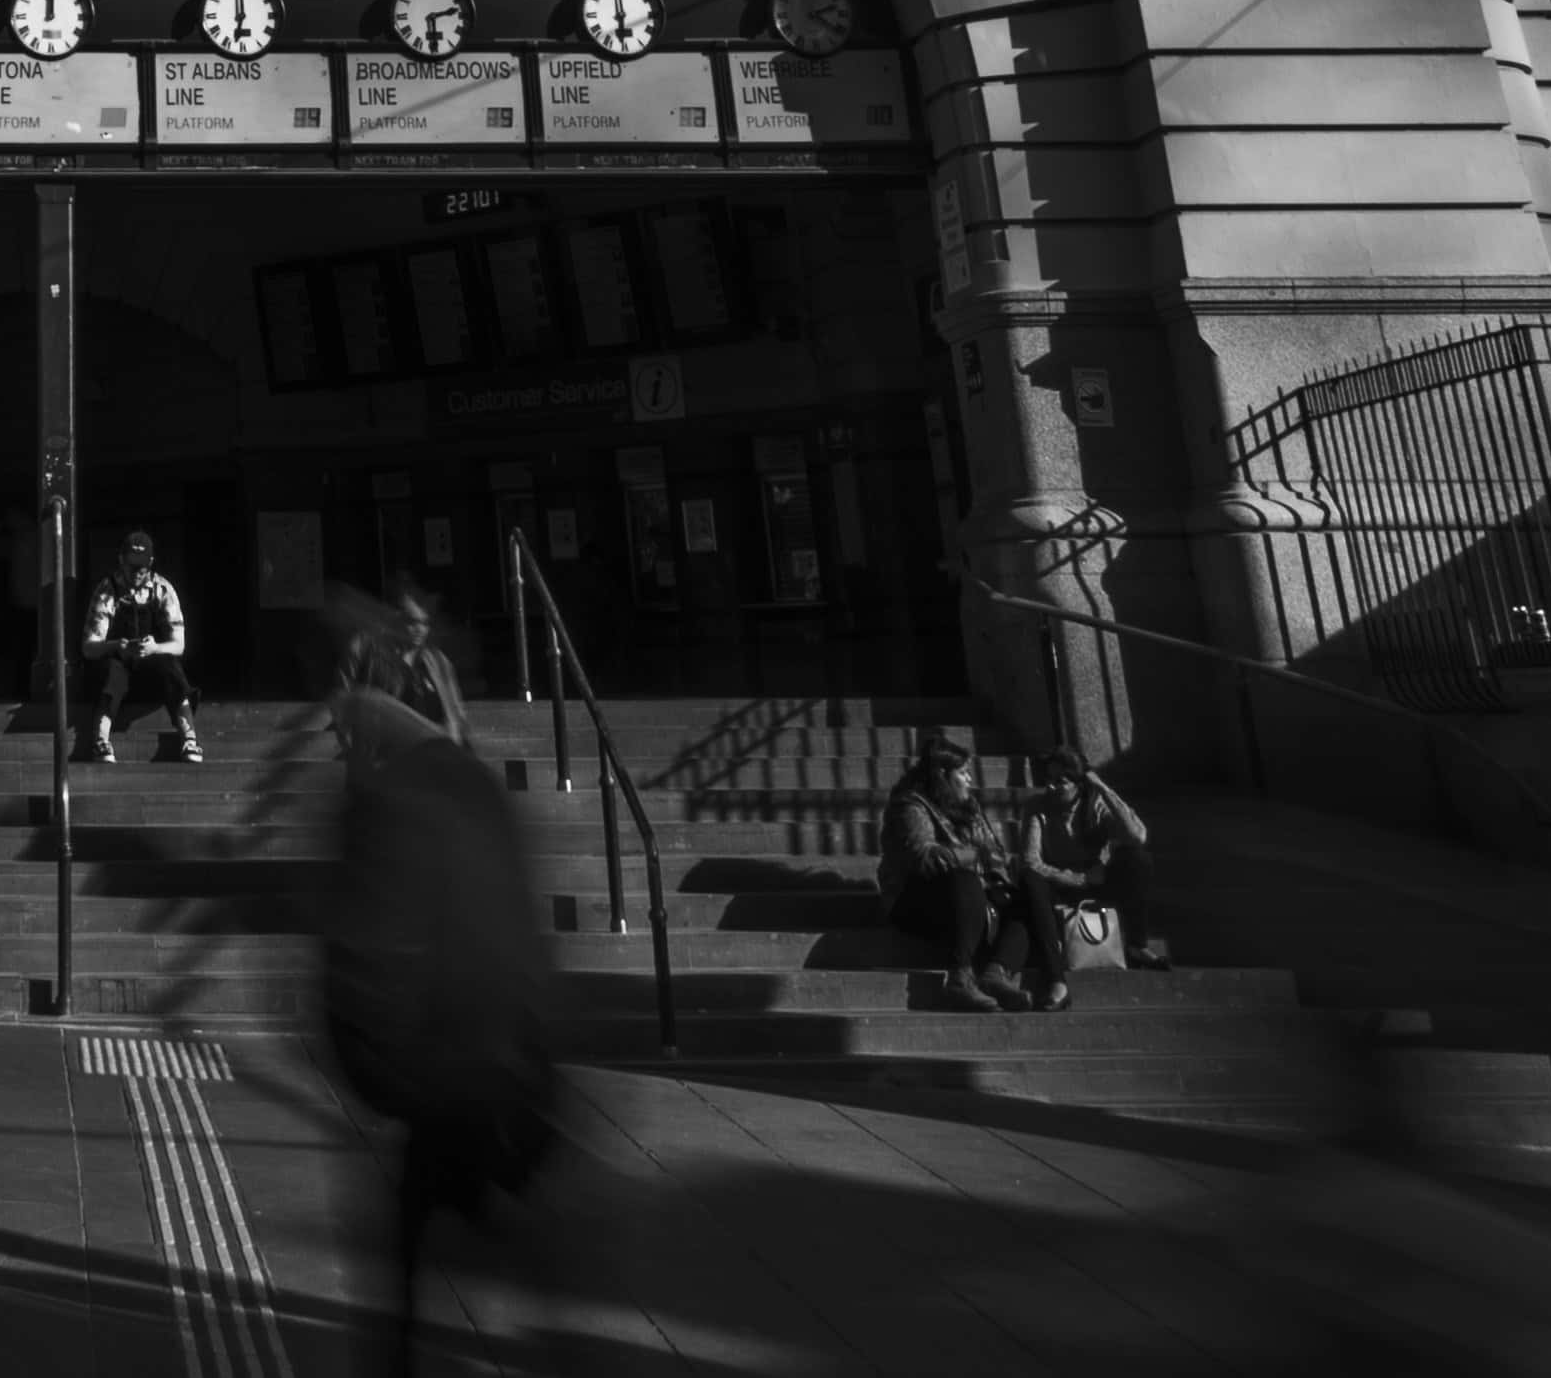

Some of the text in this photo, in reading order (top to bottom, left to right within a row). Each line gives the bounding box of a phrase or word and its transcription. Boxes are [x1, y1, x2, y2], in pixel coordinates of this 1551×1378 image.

[165, 62, 262, 81] ST ALBANS
[355, 62, 511, 81] BROADMEADOWS
[548, 61, 622, 79] UPFIELD
[739, 60, 833, 78] WERRIBEE
[165, 87, 205, 107] LINE
[358, 87, 398, 106] LINE
[551, 86, 590, 104] LINE
[742, 85, 782, 104] LINE
[165, 116, 235, 130] PLATFORM
[359, 116, 428, 130] PLATFORM
[553, 115, 621, 129] PLATFORM
[447, 379, 626, 413] Customer Service
